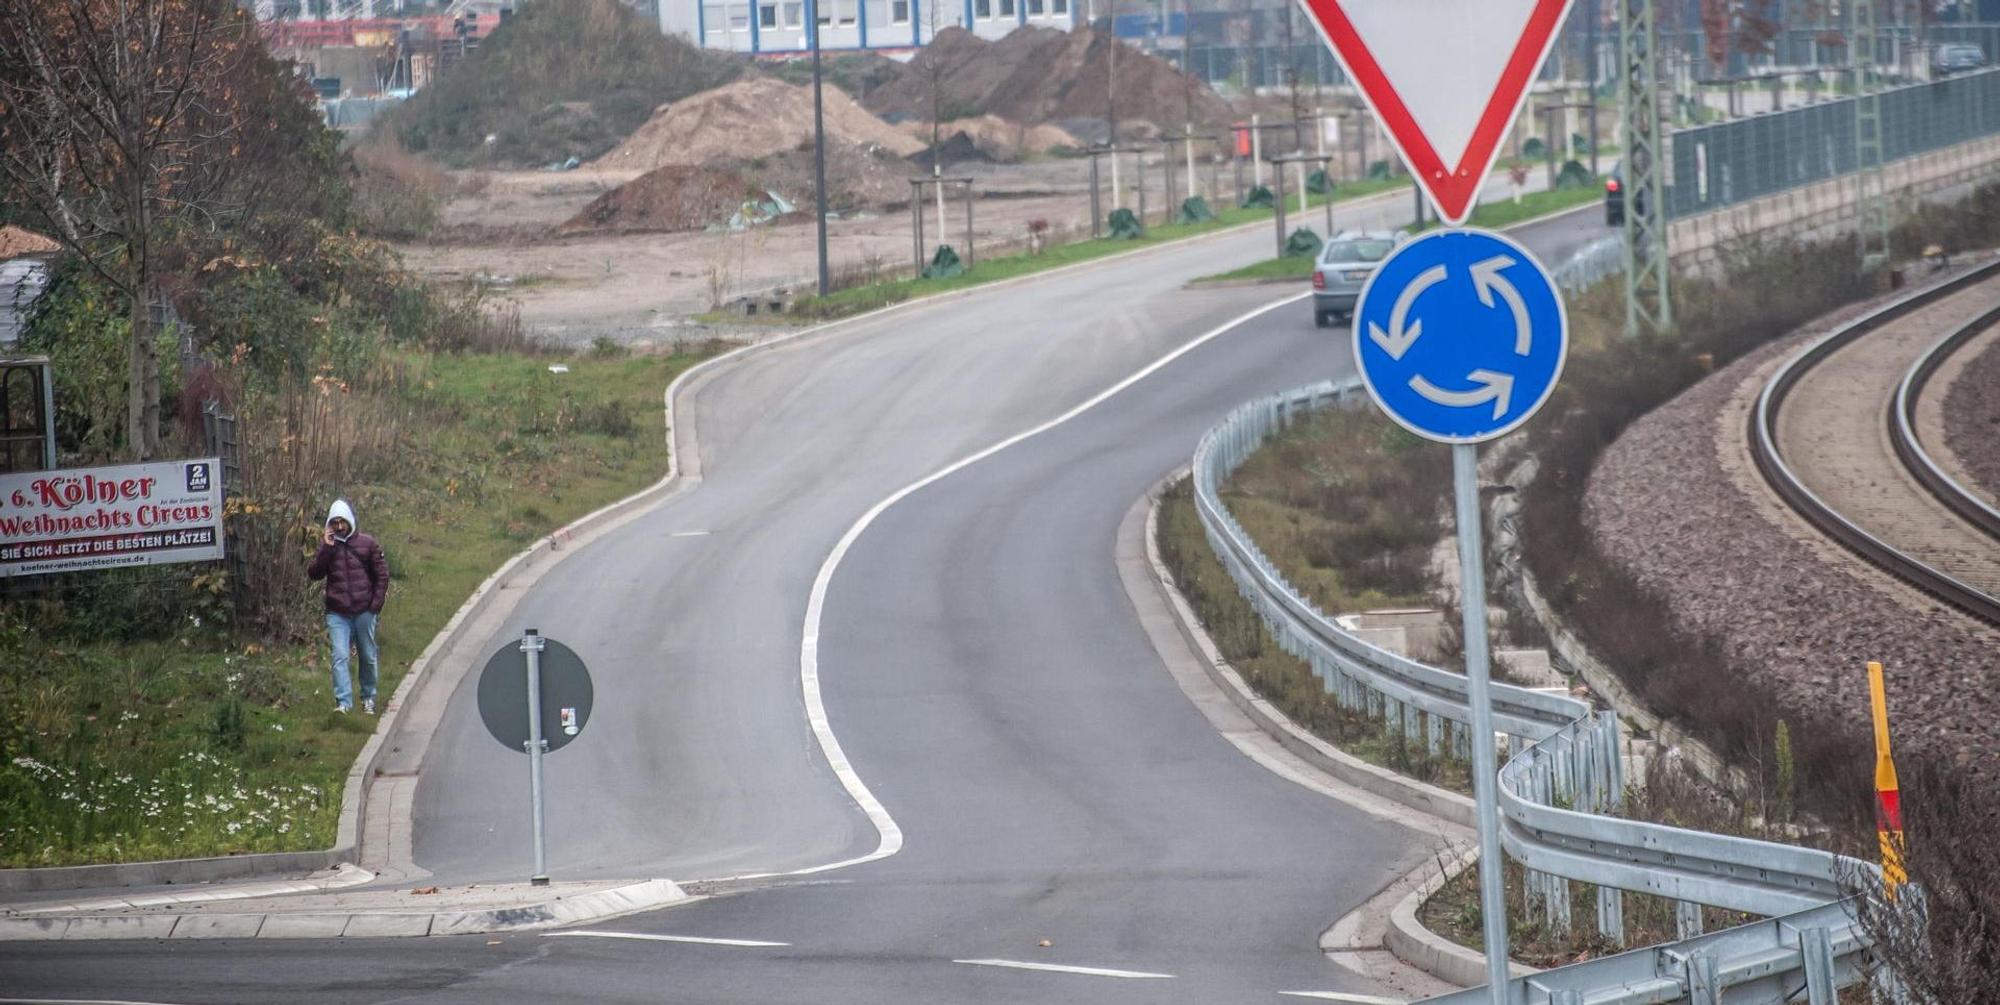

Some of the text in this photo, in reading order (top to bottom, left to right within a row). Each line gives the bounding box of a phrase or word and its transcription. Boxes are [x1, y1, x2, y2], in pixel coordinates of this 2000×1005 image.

[190, 476, 207, 486] JAN
[192, 465, 204, 477] 2
[11, 474, 156, 511] 6. Kölner
[0, 503, 212, 537] Weihnachts Circus
[1, 530, 211, 560] SIE SICH JETZT DIE BESTEN PLÄTZE!
